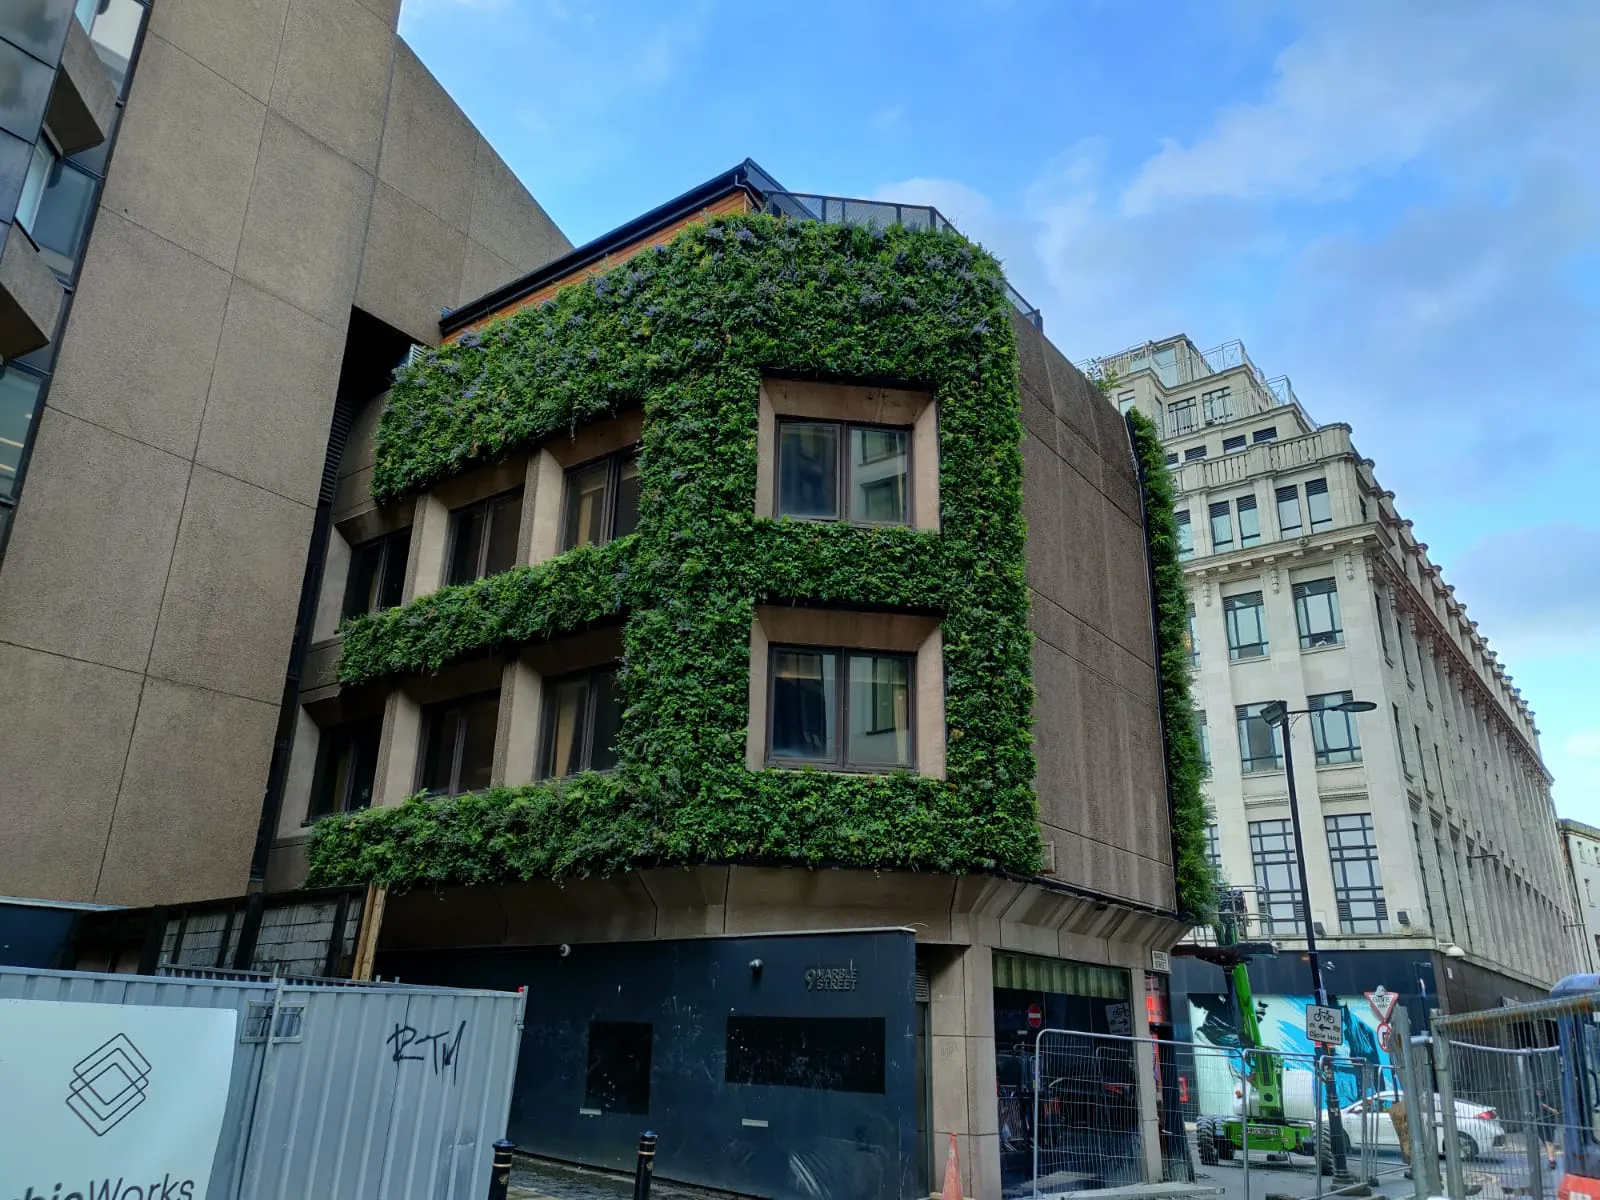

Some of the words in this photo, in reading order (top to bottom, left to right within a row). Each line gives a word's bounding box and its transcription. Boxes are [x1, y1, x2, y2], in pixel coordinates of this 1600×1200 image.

[805, 968, 816, 990] 9
[816, 968, 857, 979] MARBLE
[816, 979, 857, 990] STREET
